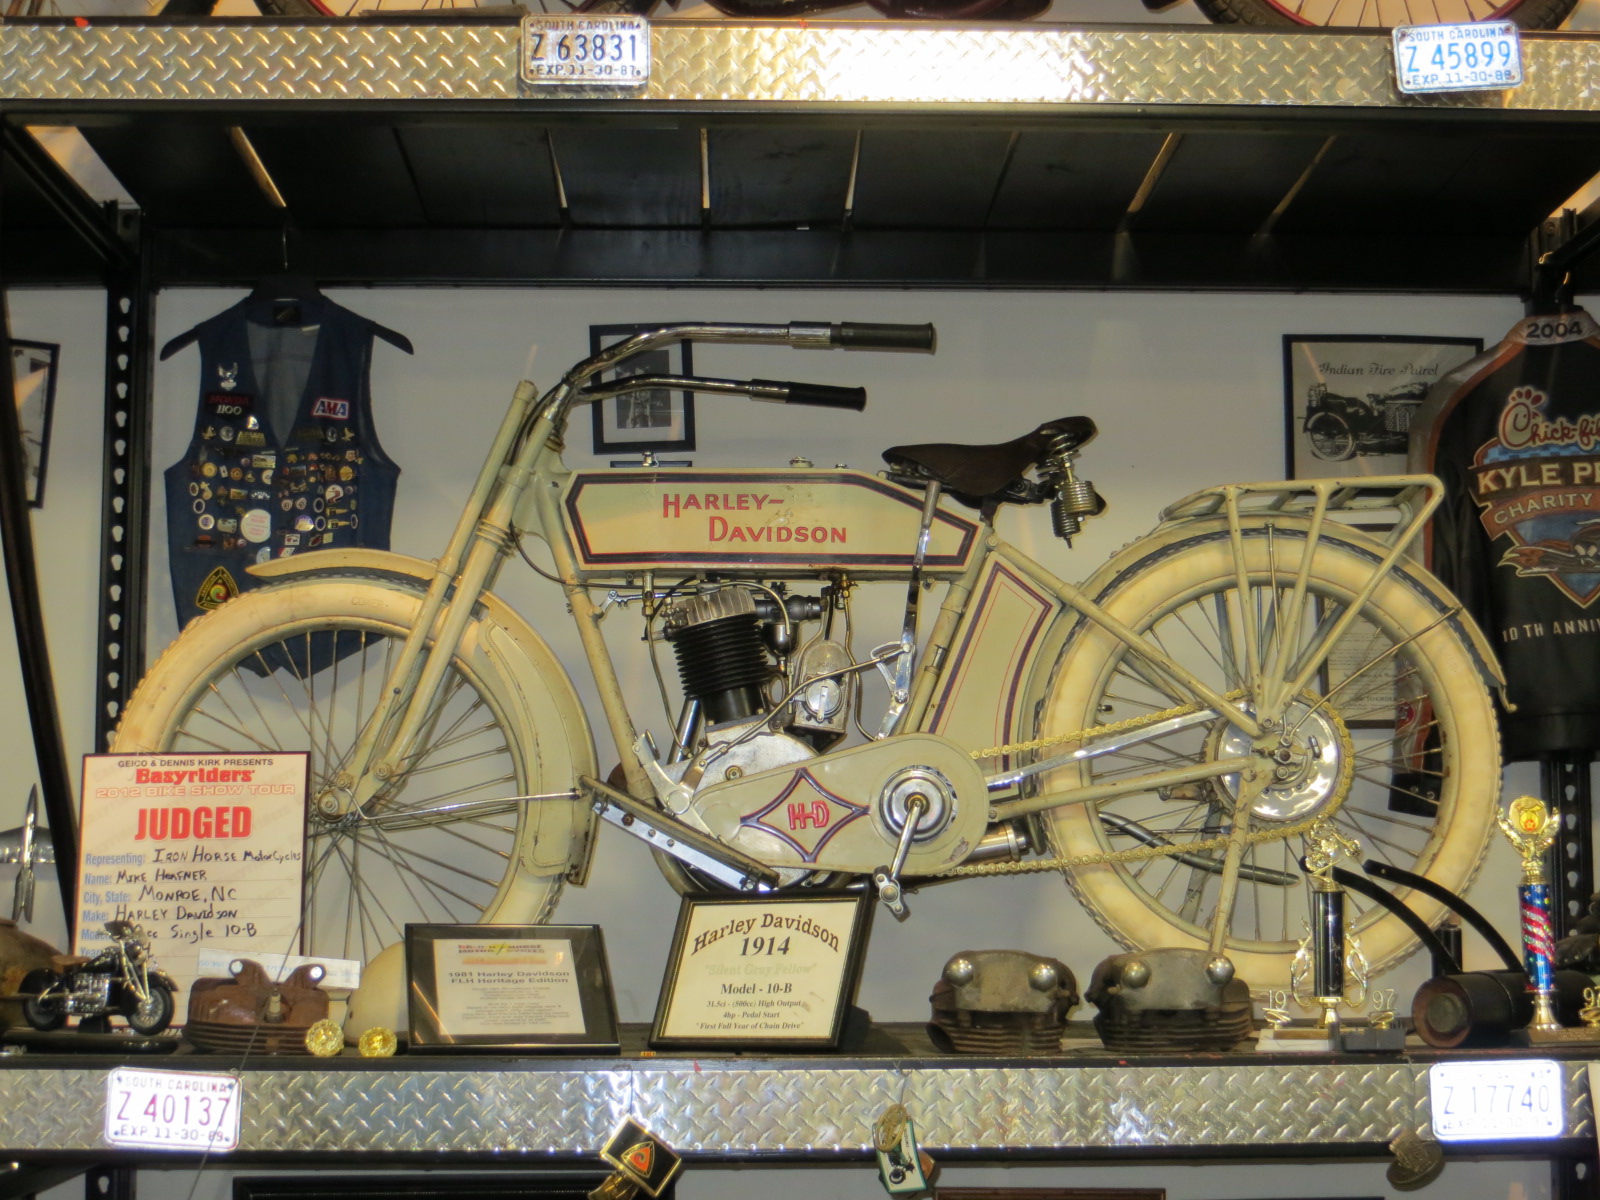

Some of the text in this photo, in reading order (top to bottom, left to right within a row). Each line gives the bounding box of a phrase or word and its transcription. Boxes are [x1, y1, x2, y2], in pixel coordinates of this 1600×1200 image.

[536, 21, 635, 31] SOUTH CAROLINA
[1408, 27, 1505, 42] SOUTH CAROLINA
[531, 33, 636, 61] Z 63831
[1405, 40, 1511, 73] Z 45899
[1526, 321, 1582, 339] 2004
[1319, 362, 1438, 376] Indian Fire Patrol
[216, 404, 242, 416] 1100
[314, 399, 348, 418] AMA
[1477, 462, 1562, 495] KYLE
[662, 493, 785, 518] HARLEY-
[1494, 493, 1593, 524] CHARITY
[708, 515, 847, 543] DAVIDSON
[1502, 627, 1518, 642] 10
[1522, 623, 1544, 638] TH
[118, 760, 148, 768] GEICO
[150, 759, 156, 767] &
[160, 759, 195, 767] DENNIS
[223, 758, 274, 766] PRESENTS
[96, 784, 296, 799] 2012 BIKE SHOW TOUR
[134, 805, 253, 841] JUDGED
[85, 853, 146, 868] Representing:
[84, 873, 112, 885] Name:
[83, 891, 103, 906] City,
[105, 891, 132, 903] State:
[211, 886, 237, 901] NC
[82, 909, 109, 922] Make:
[170, 922, 215, 944] Single
[225, 923, 258, 938] 10-B
[691, 912, 840, 956] Harley Davidson
[739, 935, 792, 957] 1914
[743, 963, 773, 977] Gray
[720, 983, 756, 995] Model
[767, 982, 793, 994] 10-B
[758, 1000, 775, 1009] High
[776, 999, 802, 1009] Output
[1269, 989, 1287, 1010] 19
[1373, 988, 1395, 1010] 97
[742, 1011, 761, 1019] Pedal
[125, 1076, 228, 1093] SOUTH CAROLINA
[117, 1090, 231, 1127] Z 40137
[1443, 1084, 1550, 1115] Z 17740
